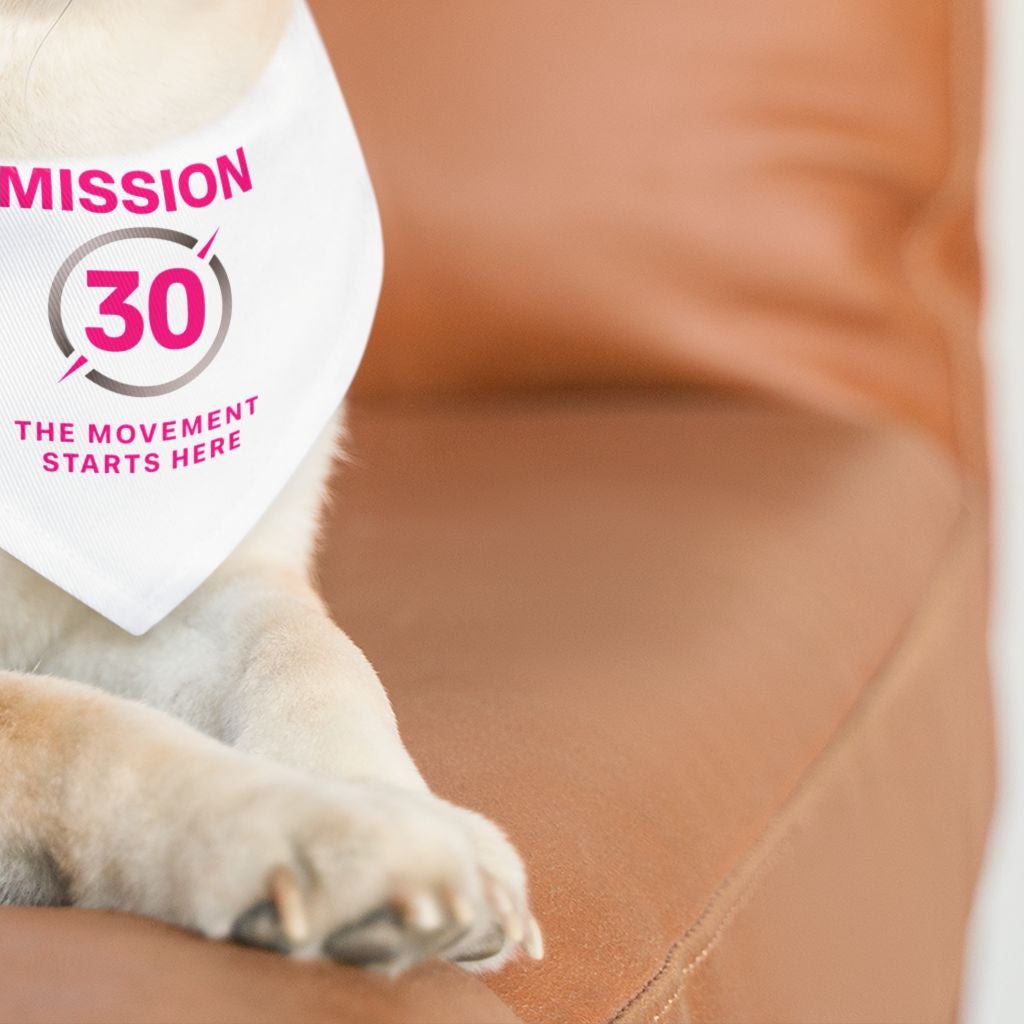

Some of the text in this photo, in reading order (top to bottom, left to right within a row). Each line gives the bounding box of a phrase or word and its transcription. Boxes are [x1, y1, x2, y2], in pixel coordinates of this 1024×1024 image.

[85, 268, 206, 353] 30
[14, 395, 259, 445] THE MOVEMENT
[42, 429, 242, 475] STARTS HERE
